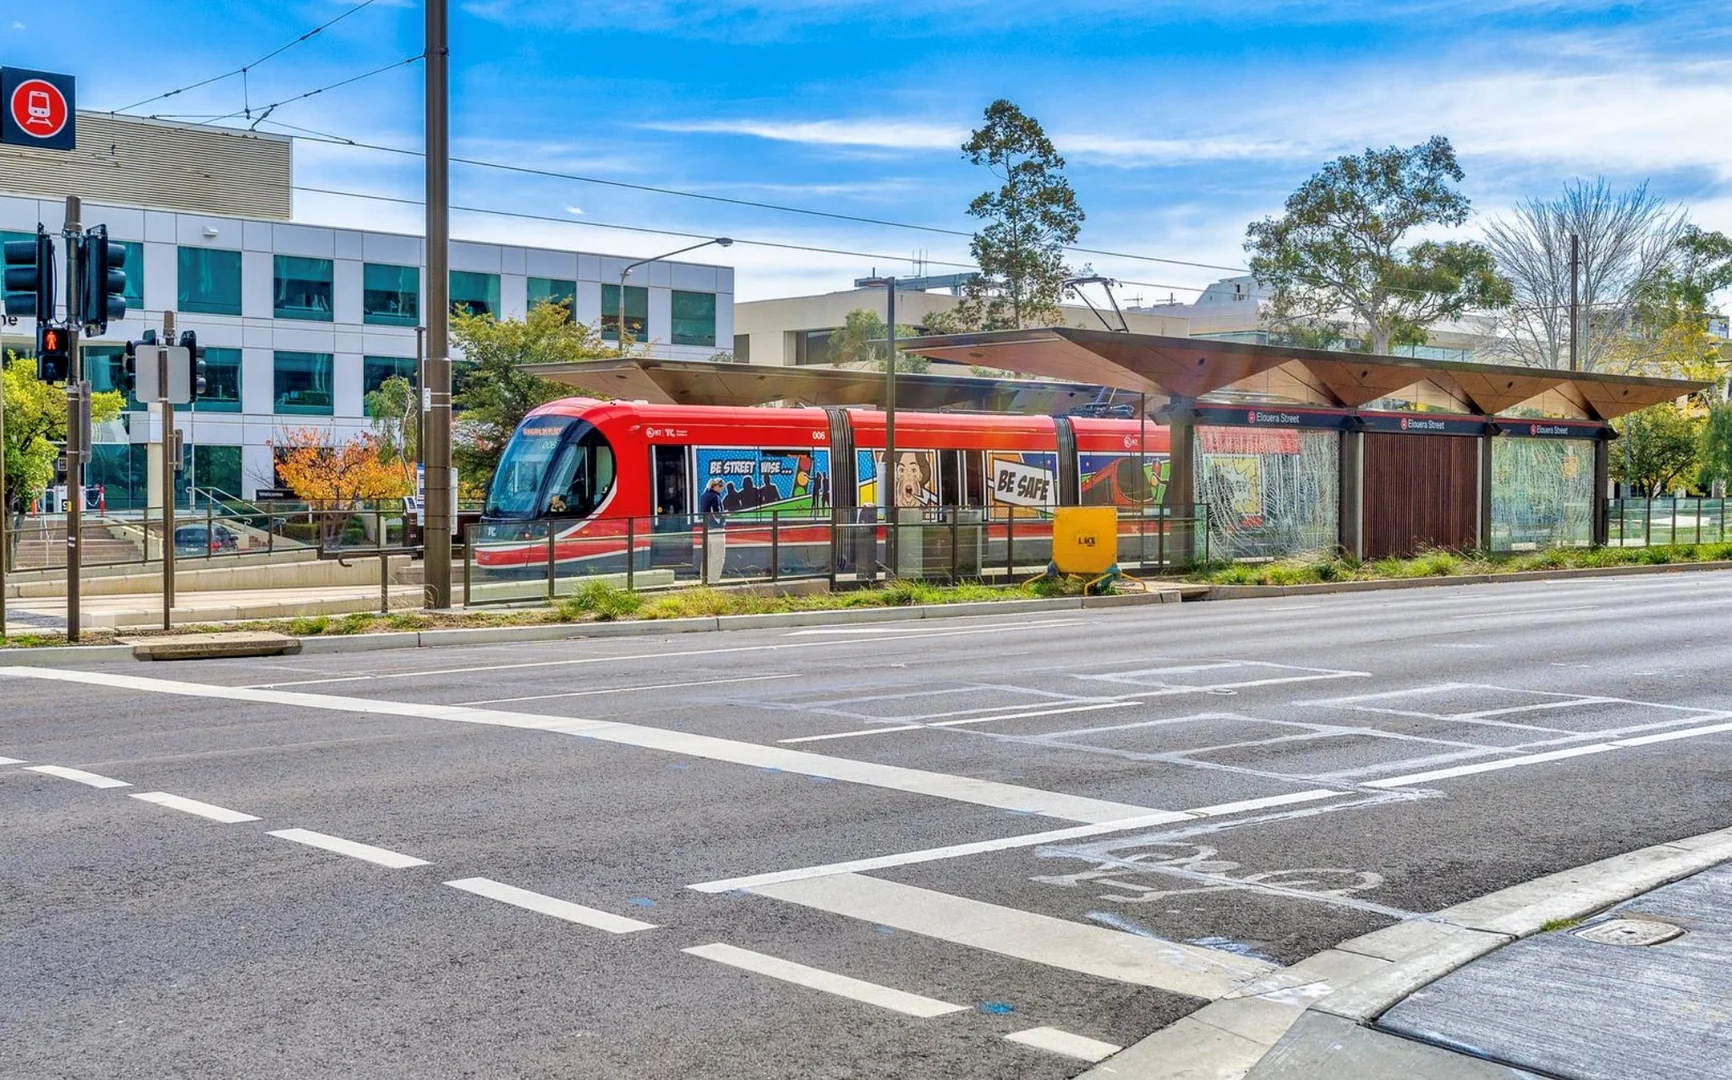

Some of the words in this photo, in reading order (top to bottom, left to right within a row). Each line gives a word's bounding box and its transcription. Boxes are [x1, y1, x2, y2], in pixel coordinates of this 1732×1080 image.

[1256, 411, 1280, 423] Elouera
[1280, 412, 1300, 424] Street
[1407, 418, 1428, 429] Elouera
[1428, 419, 1445, 430] Street
[1536, 424, 1553, 434] Elouera
[1553, 425, 1568, 435] Street
[812, 430, 826, 441] 006
[709, 460, 722, 475] BE
[722, 460, 755, 474] STREET
[997, 469, 1016, 493] BE
[1017, 474, 1050, 501] SAFE
